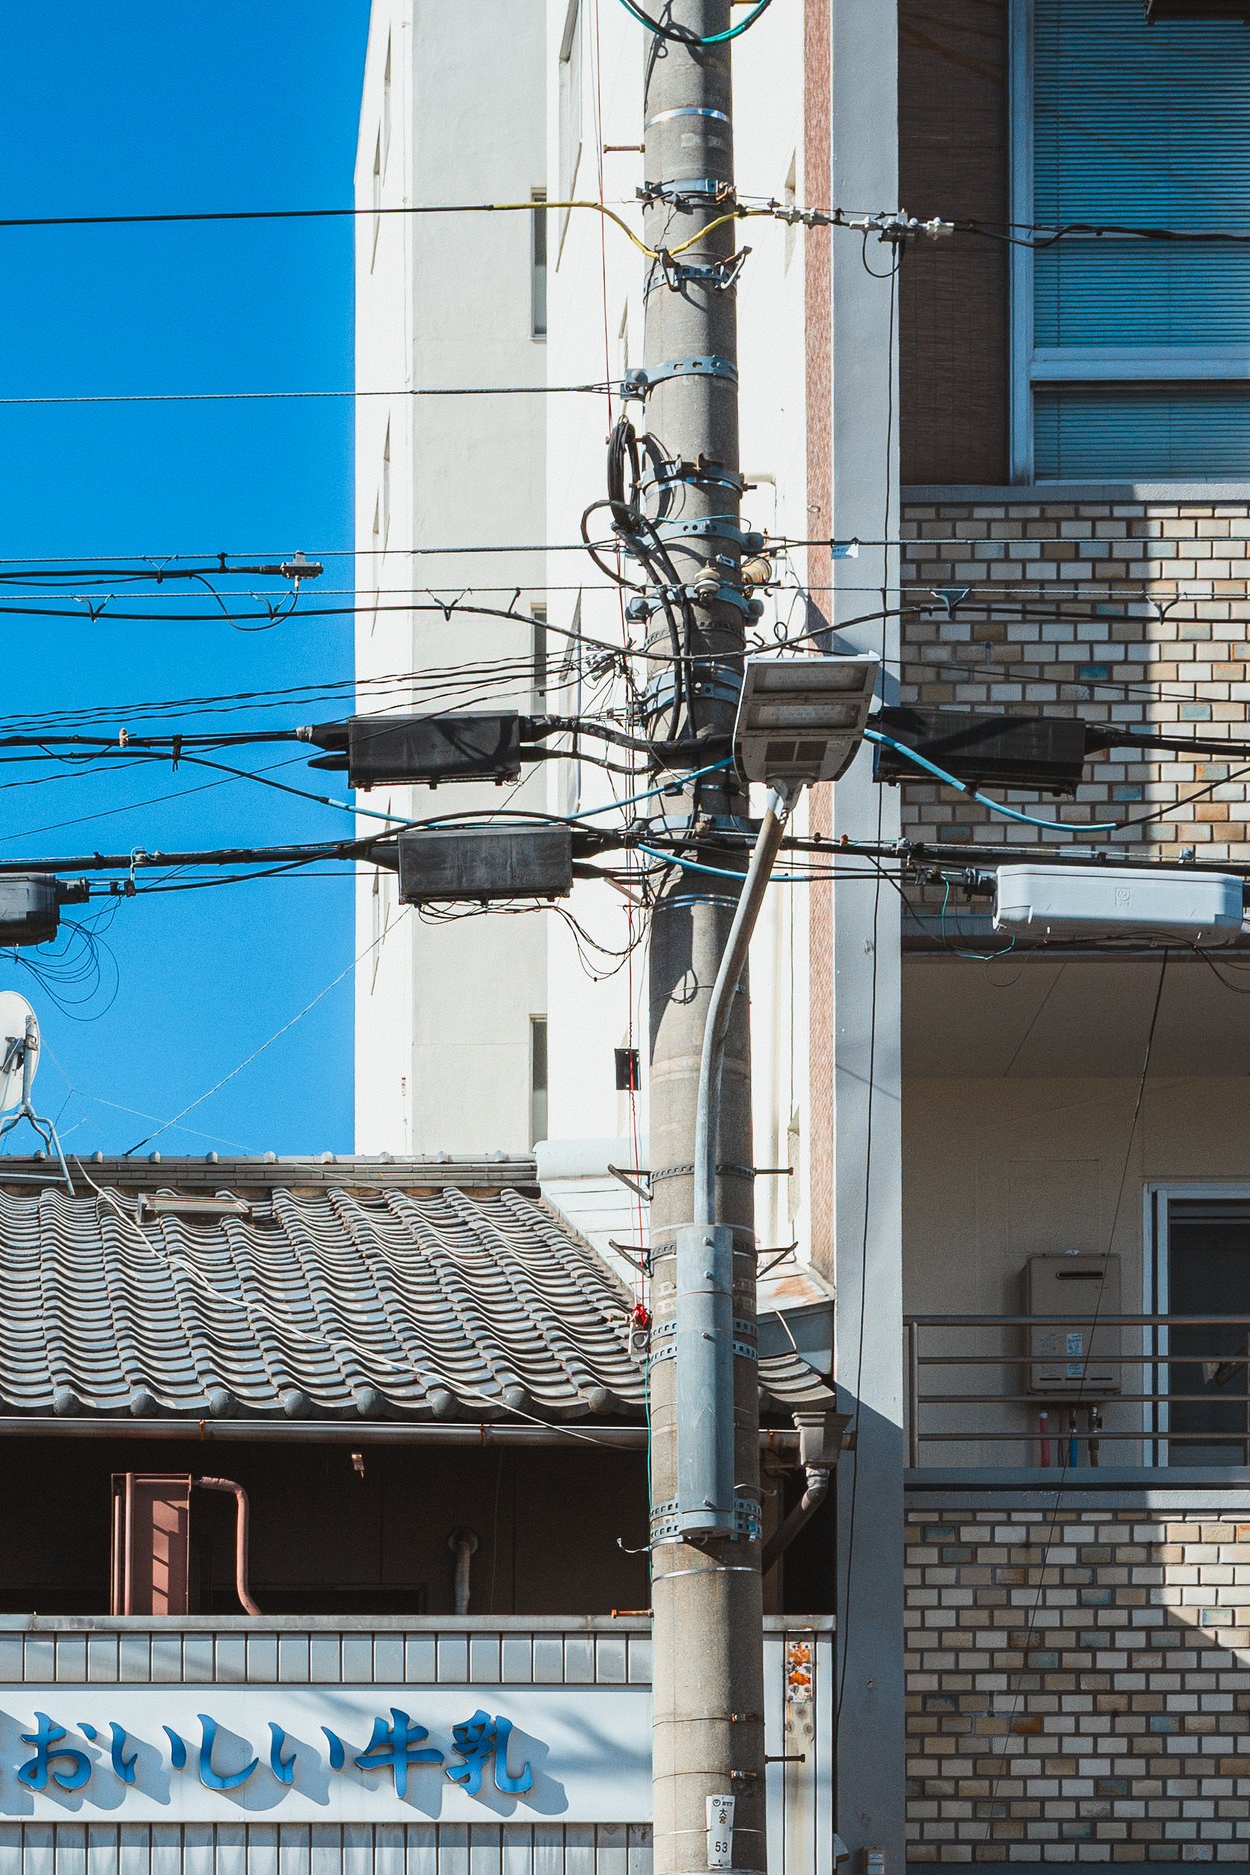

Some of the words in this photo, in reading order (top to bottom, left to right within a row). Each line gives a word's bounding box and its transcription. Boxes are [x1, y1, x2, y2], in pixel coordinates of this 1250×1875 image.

[17, 1707, 533, 1797] おいしい牛乳
[715, 1841, 728, 1853] 53
